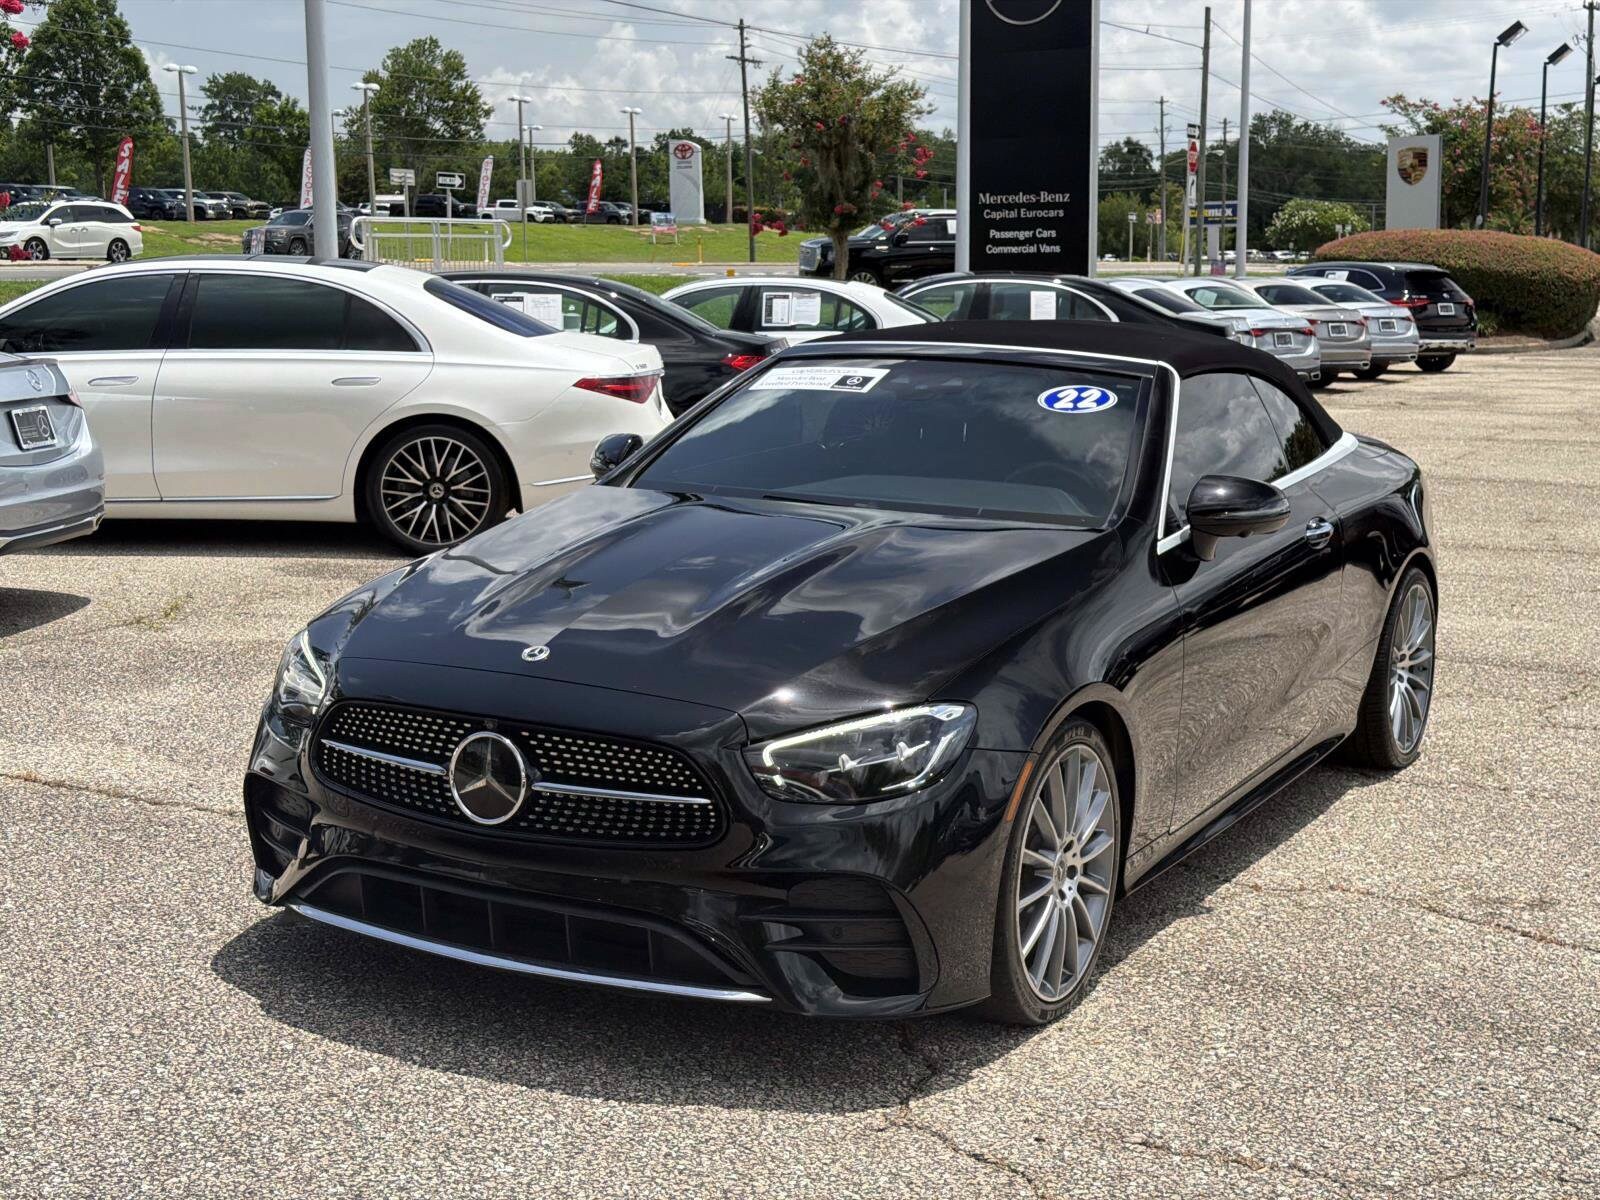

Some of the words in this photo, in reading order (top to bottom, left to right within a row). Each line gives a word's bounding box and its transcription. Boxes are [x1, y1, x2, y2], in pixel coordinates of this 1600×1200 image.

[113, 142, 133, 203] SALE
[587, 163, 602, 209] SALE
[978, 191, 1071, 205] Mercedes-Benz
[983, 208, 1018, 220] Capital
[1020, 208, 1065, 218] Eurocars
[989, 229, 1034, 240] Passenger
[1036, 228, 1057, 238] Cars
[985, 244, 1037, 254] Commercial
[1039, 243, 1061, 253] Vans
[1053, 388, 1102, 408] 22
